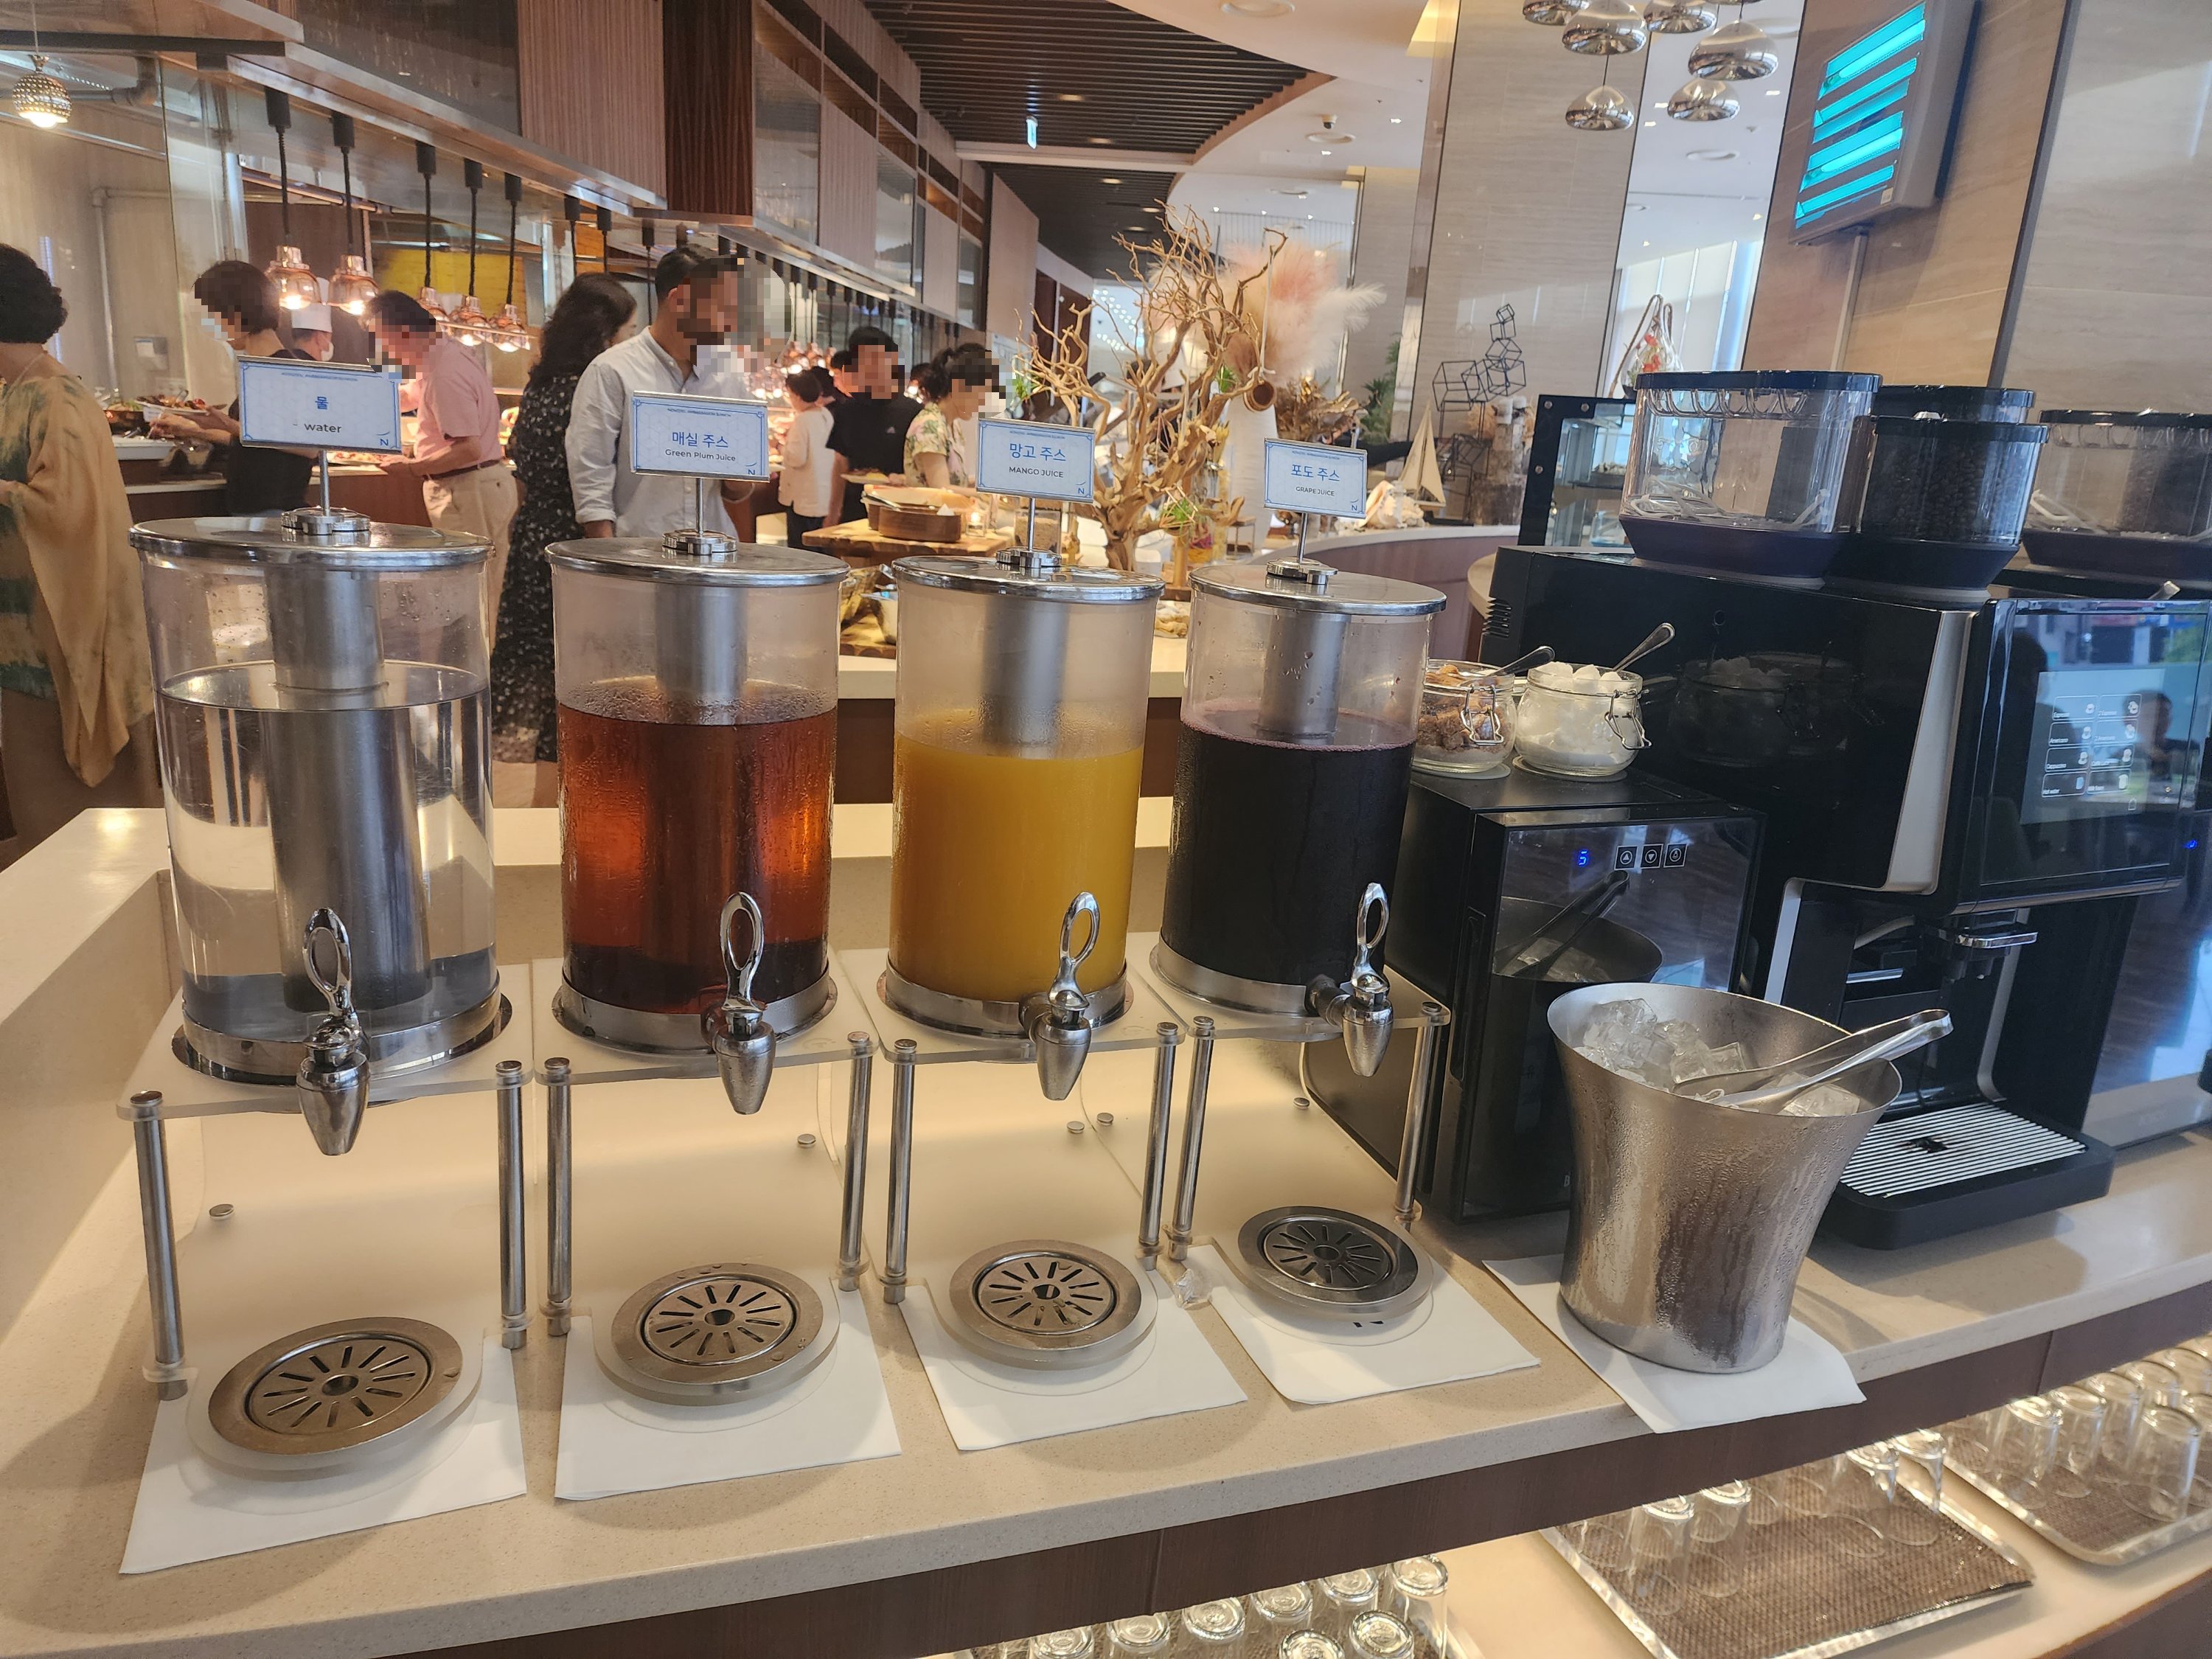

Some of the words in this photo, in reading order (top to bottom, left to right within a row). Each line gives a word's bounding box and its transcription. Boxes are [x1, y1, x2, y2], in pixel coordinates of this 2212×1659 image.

[315, 396, 329, 410] 물
[304, 423, 342, 434] water
[380, 438, 389, 446] N
[672, 431, 698, 447] 매실
[702, 434, 728, 448] 주스
[665, 448, 692, 458] Green
[694, 451, 714, 459] Plum
[716, 453, 736, 462] Juice
[1009, 443, 1036, 459] 망고
[1040, 447, 1066, 462] 주스
[1009, 466, 1040, 476] MANGO
[1041, 470, 1064, 478] JUICE
[1290, 464, 1314, 478] 포도
[1317, 467, 1340, 481] 주스
[1295, 486, 1316, 494] GRAPE
[1578, 849, 1587, 866] 5
